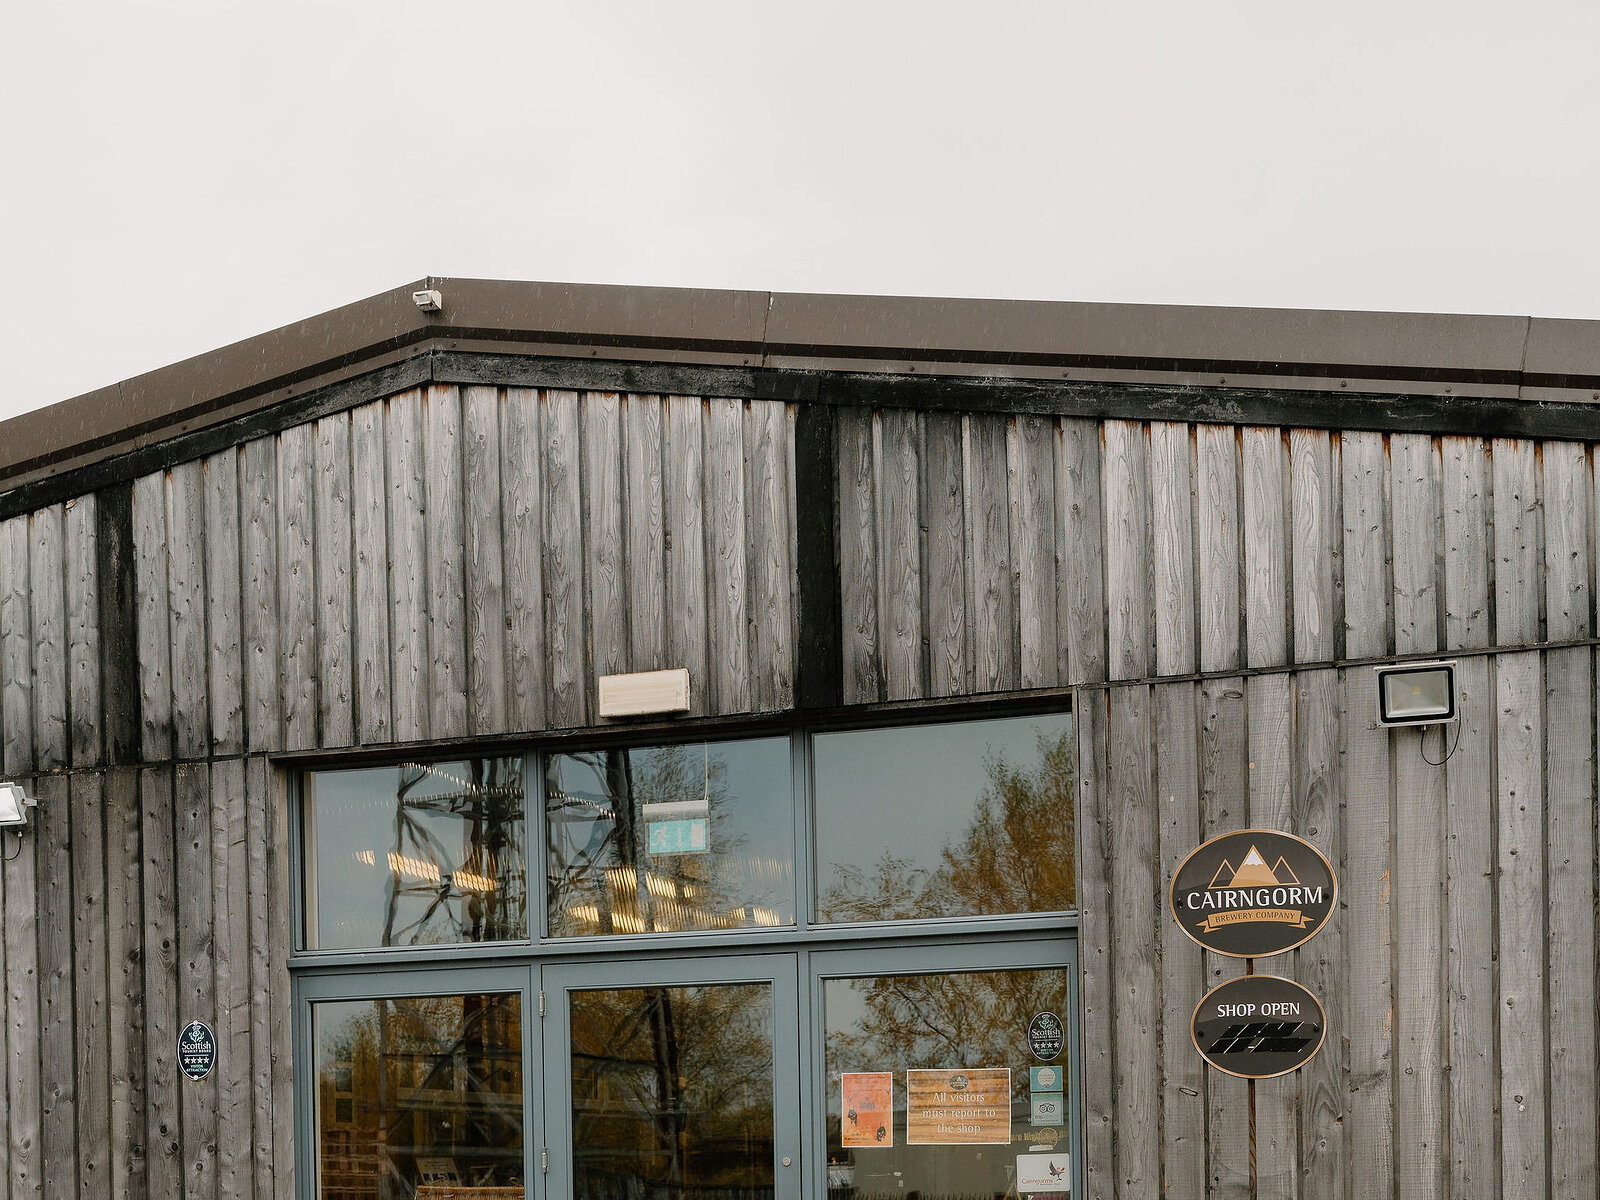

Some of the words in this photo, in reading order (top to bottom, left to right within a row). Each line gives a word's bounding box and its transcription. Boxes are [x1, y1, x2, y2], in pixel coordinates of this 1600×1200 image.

[1187, 886, 1322, 910] CAIRNGORM
[1215, 911, 1252, 923] BREWERY
[1255, 911, 1295, 920] COMPANY
[1217, 1003, 1256, 1018] SHOP
[1261, 1002, 1300, 1016] OPEN
[1031, 1028, 1060, 1036] Scottish
[182, 1041, 211, 1050] Scottish
[932, 1092, 947, 1102] All
[950, 1092, 985, 1102] visitors
[922, 1109, 947, 1118] must
[951, 1109, 981, 1119] report
[985, 1109, 996, 1118] to
[937, 1124, 954, 1133] the
[957, 1123, 981, 1135] shop
